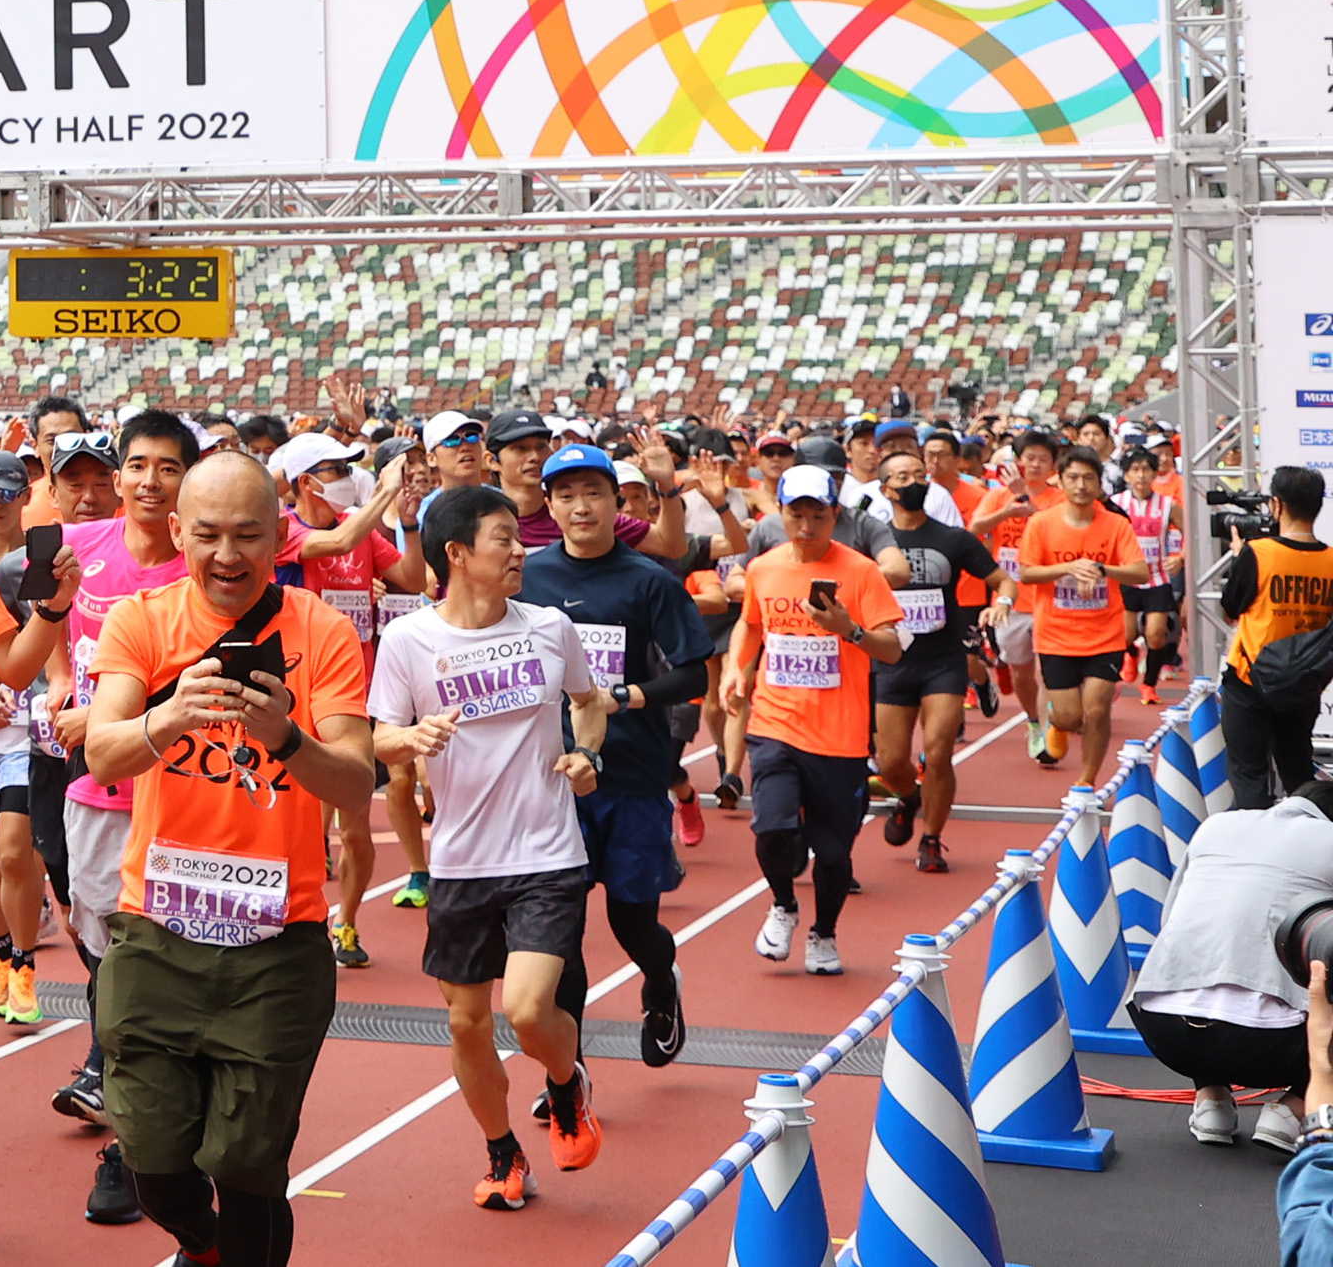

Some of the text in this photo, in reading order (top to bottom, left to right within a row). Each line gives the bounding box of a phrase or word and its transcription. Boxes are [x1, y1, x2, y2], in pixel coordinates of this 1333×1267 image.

[56, 114, 145, 143] HALF
[158, 111, 250, 140] 2022
[54, 309, 181, 334] SEIKO
[83, 599, 101, 612] Run
[764, 598, 804, 613] TOK
[581, 631, 622, 645] 2022
[802, 641, 837, 652] 2022
[449, 639, 535, 664] TOKYO 2022
[769, 653, 829, 672] B12578
[443, 662, 531, 700] B11776
[173, 869, 199, 879] LEGACY
[174, 858, 283, 888] TOKYO 2022
[152, 882, 262, 920] B14178
